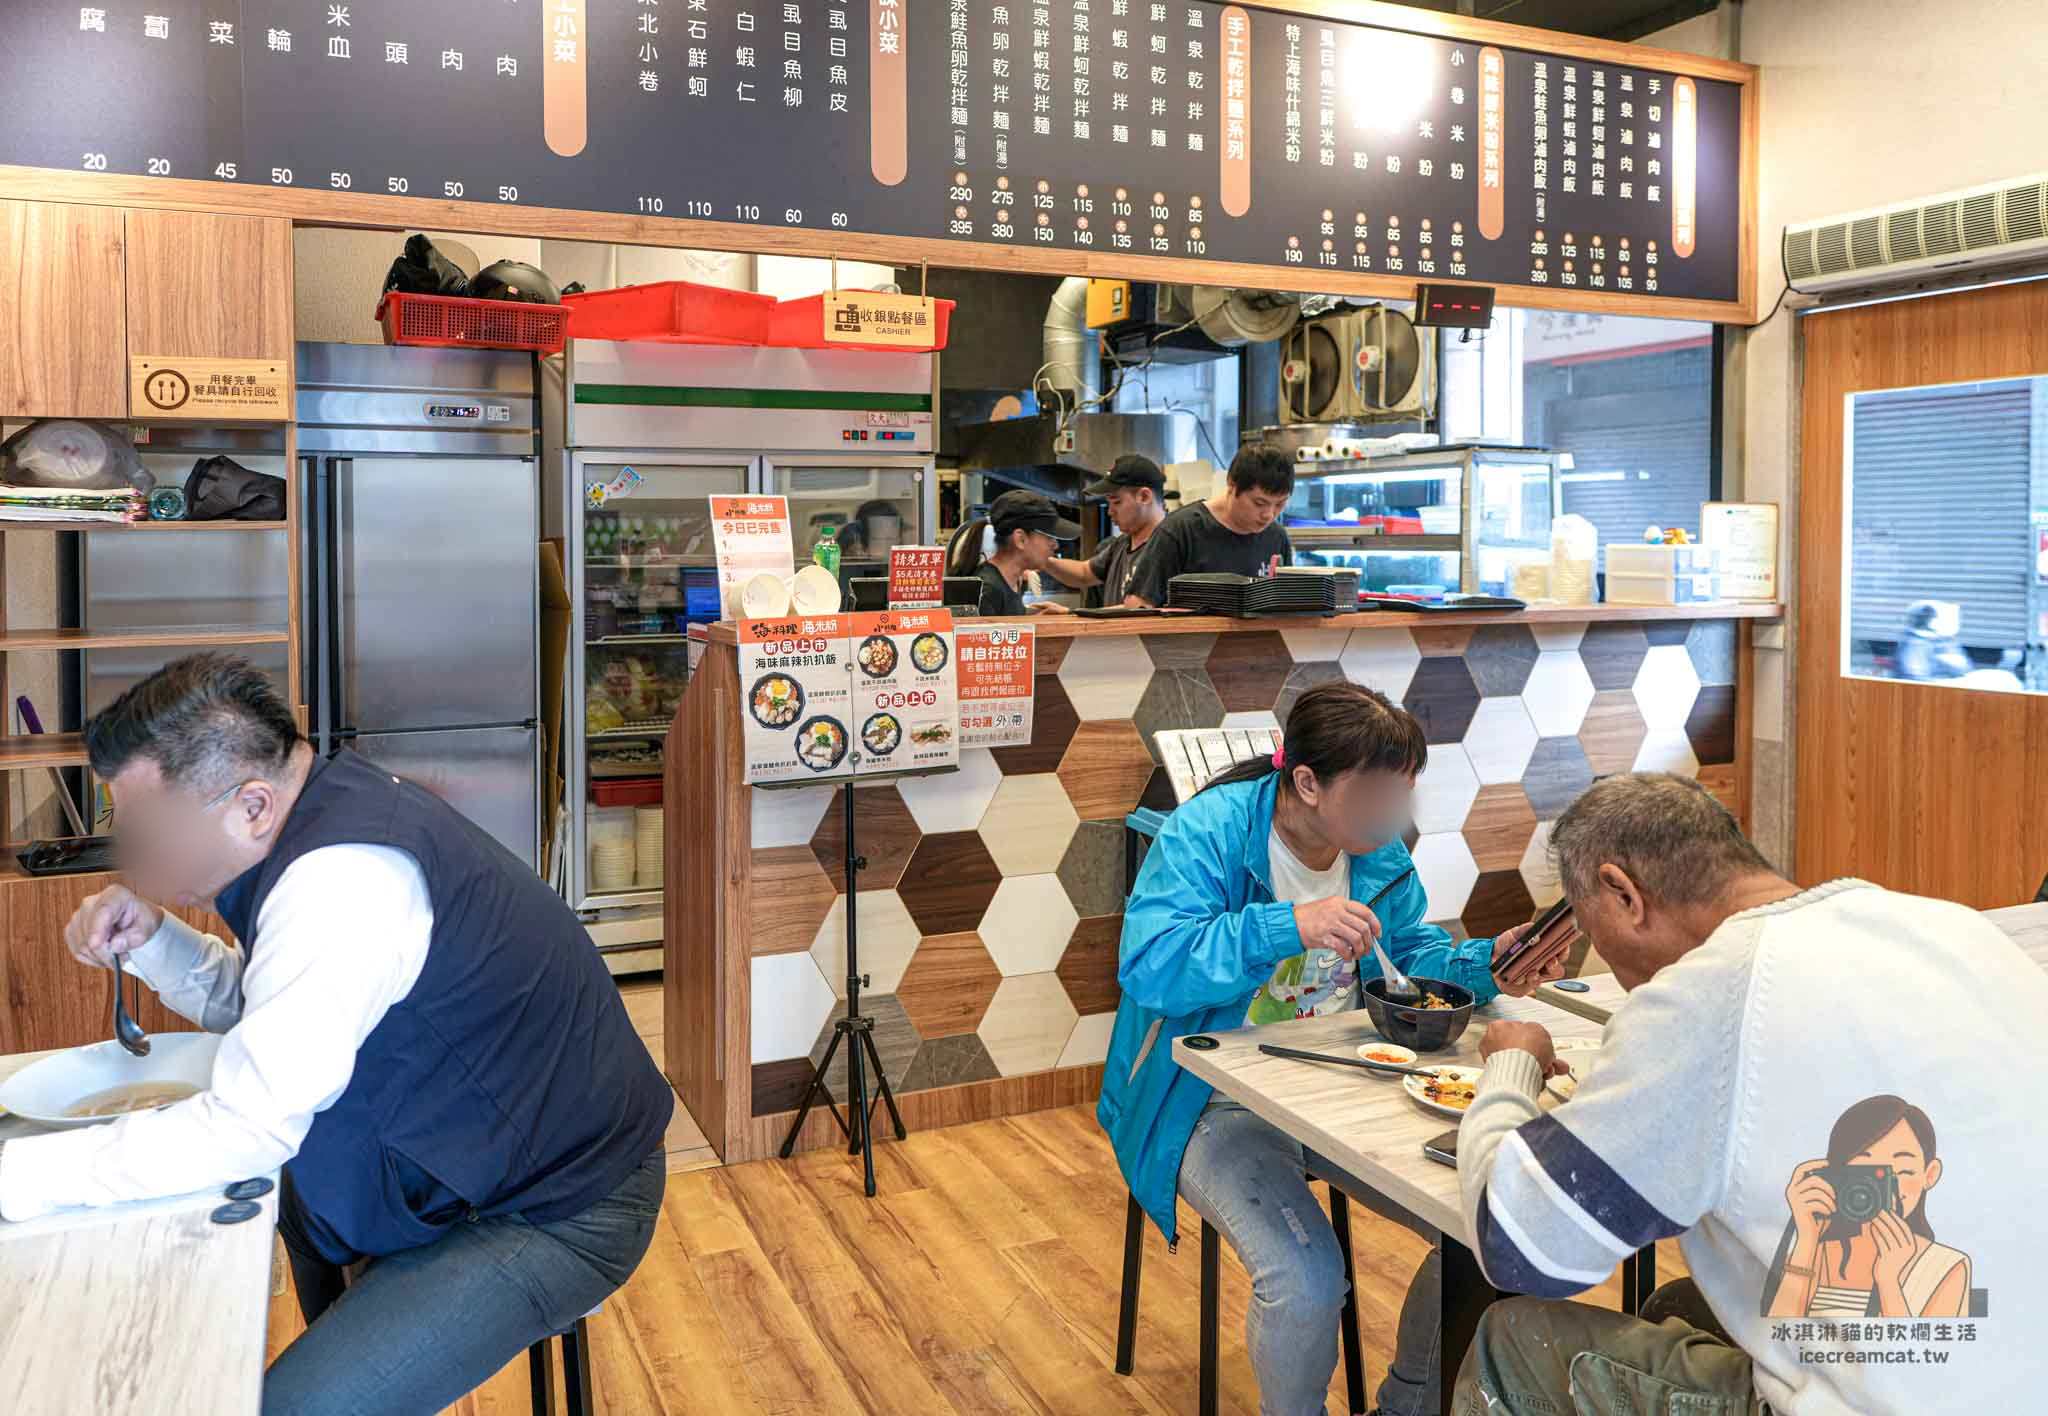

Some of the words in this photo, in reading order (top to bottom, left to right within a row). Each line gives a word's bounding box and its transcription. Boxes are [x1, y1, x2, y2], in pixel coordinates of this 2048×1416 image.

[79, 7, 106, 33] 腐
[209, 21, 234, 45] 菜
[267, 27, 292, 52] 輪
[327, 4, 352, 59] 米血
[385, 41, 409, 65] 頭
[441, 48, 463, 71] 肉
[736, 11, 756, 102] 白蝦仁
[783, 3, 802, 108] 虱目魚柳
[827, 0, 850, 113] 虱目魚皮
[1033, 0, 1051, 135] 泉鮮蝦乾拌麵
[83, 153, 107, 170] 20
[148, 158, 170, 175] 20
[214, 162, 237, 179] 45
[271, 167, 293, 185] 50
[330, 172, 351, 189] 50
[388, 176, 409, 193] 50
[444, 181, 464, 198] 50
[499, 185, 518, 202] 50
[950, 186, 973, 201] 290
[991, 190, 1014, 205] 275
[638, 196, 663, 213] 110
[687, 200, 712, 216] 110
[1033, 194, 1054, 209] 125
[1073, 198, 1093, 213] 115
[1111, 201, 1132, 217] 110
[735, 204, 760, 220] 110
[785, 208, 802, 224] 60
[831, 212, 848, 227] 60
[1150, 205, 1169, 220] 100
[1188, 209, 1202, 223] 85
[950, 220, 973, 235] 395
[991, 223, 1014, 238] 380
[1033, 227, 1054, 241] 150
[1073, 230, 1093, 245] 140
[1111, 234, 1132, 248] 135
[1150, 237, 1169, 251] 125
[1186, 240, 1206, 254] 110
[1285, 249, 1303, 263] 190
[1319, 252, 1337, 266] 115
[1352, 255, 1371, 268] 115
[1386, 257, 1403, 270] 105
[1418, 260, 1435, 273] 105
[1449, 263, 1466, 276] 105
[860, 308, 927, 326] 收銀點餐區
[875, 327, 911, 336] CASHIER
[209, 374, 257, 385] 用餐完畢
[193, 385, 277, 397] 餐具請自行回收
[764, 638, 828, 655] 新品上市
[960, 647, 1027, 662] 請自行找位
[754, 653, 838, 669] 海味麻辣扒扒飯
[876, 690, 937, 709] 新品上市
